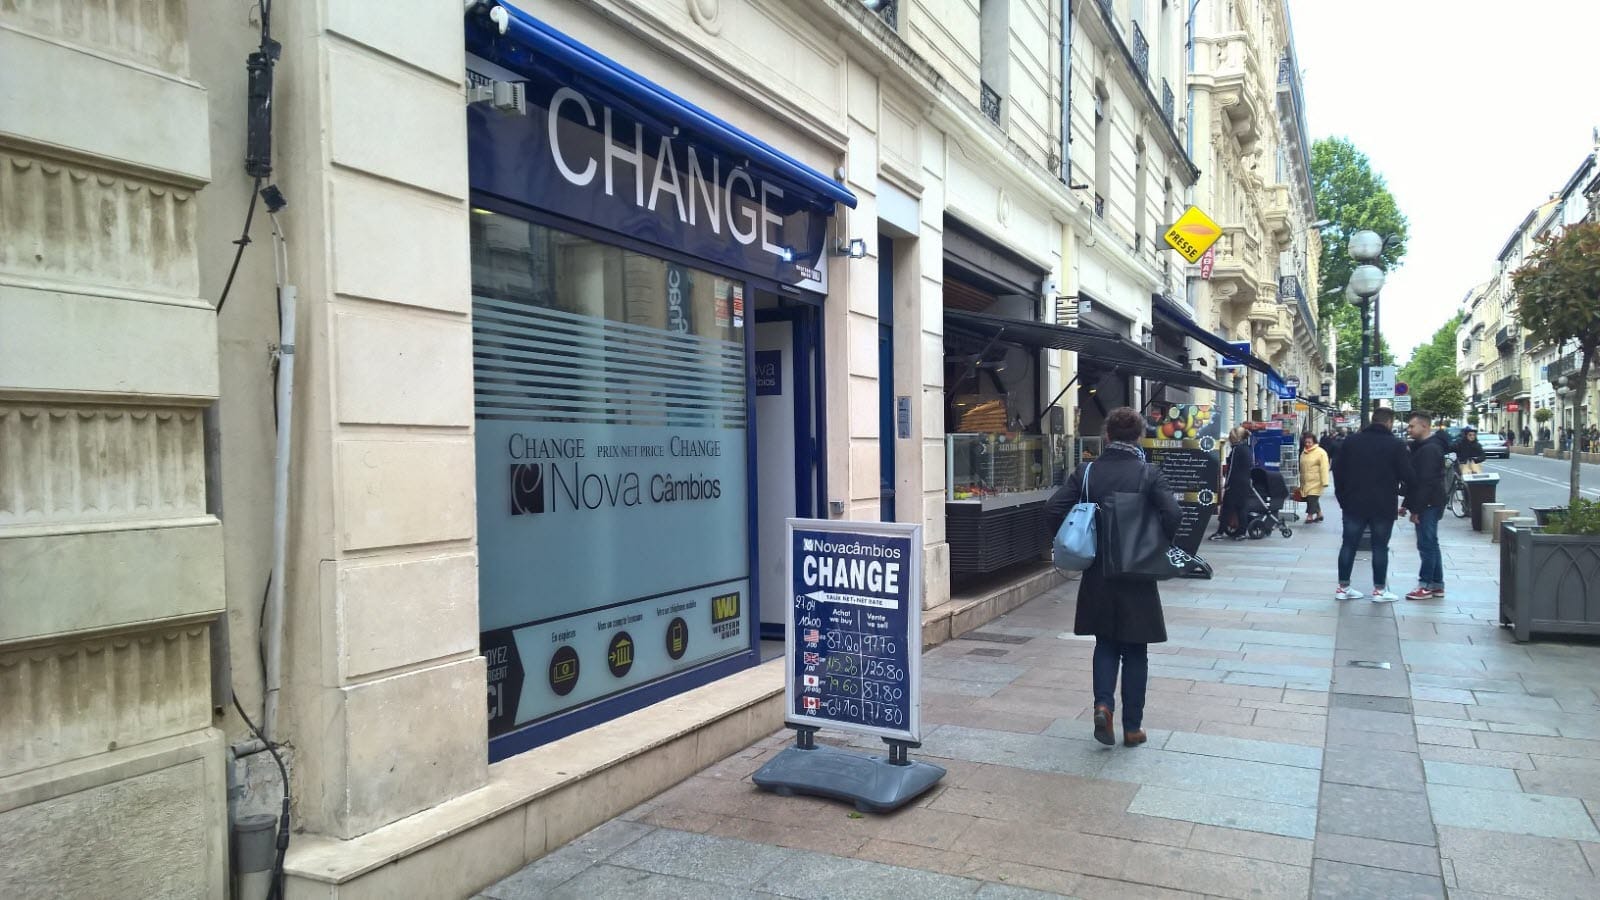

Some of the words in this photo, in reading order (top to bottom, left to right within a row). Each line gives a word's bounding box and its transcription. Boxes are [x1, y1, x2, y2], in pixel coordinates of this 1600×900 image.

[547, 86, 786, 256] CHANGE
[1168, 230, 1198, 258] PRESSE
[1202, 250, 1214, 279] ABAC
[551, 461, 642, 513] Nova
[650, 472, 722, 504] Câmbios
[814, 539, 901, 559] Novacâmbios
[803, 554, 900, 594] CHANGE
[832, 608, 851, 617] Achat
[840, 616, 853, 626] buy
[867, 612, 886, 621] Vente
